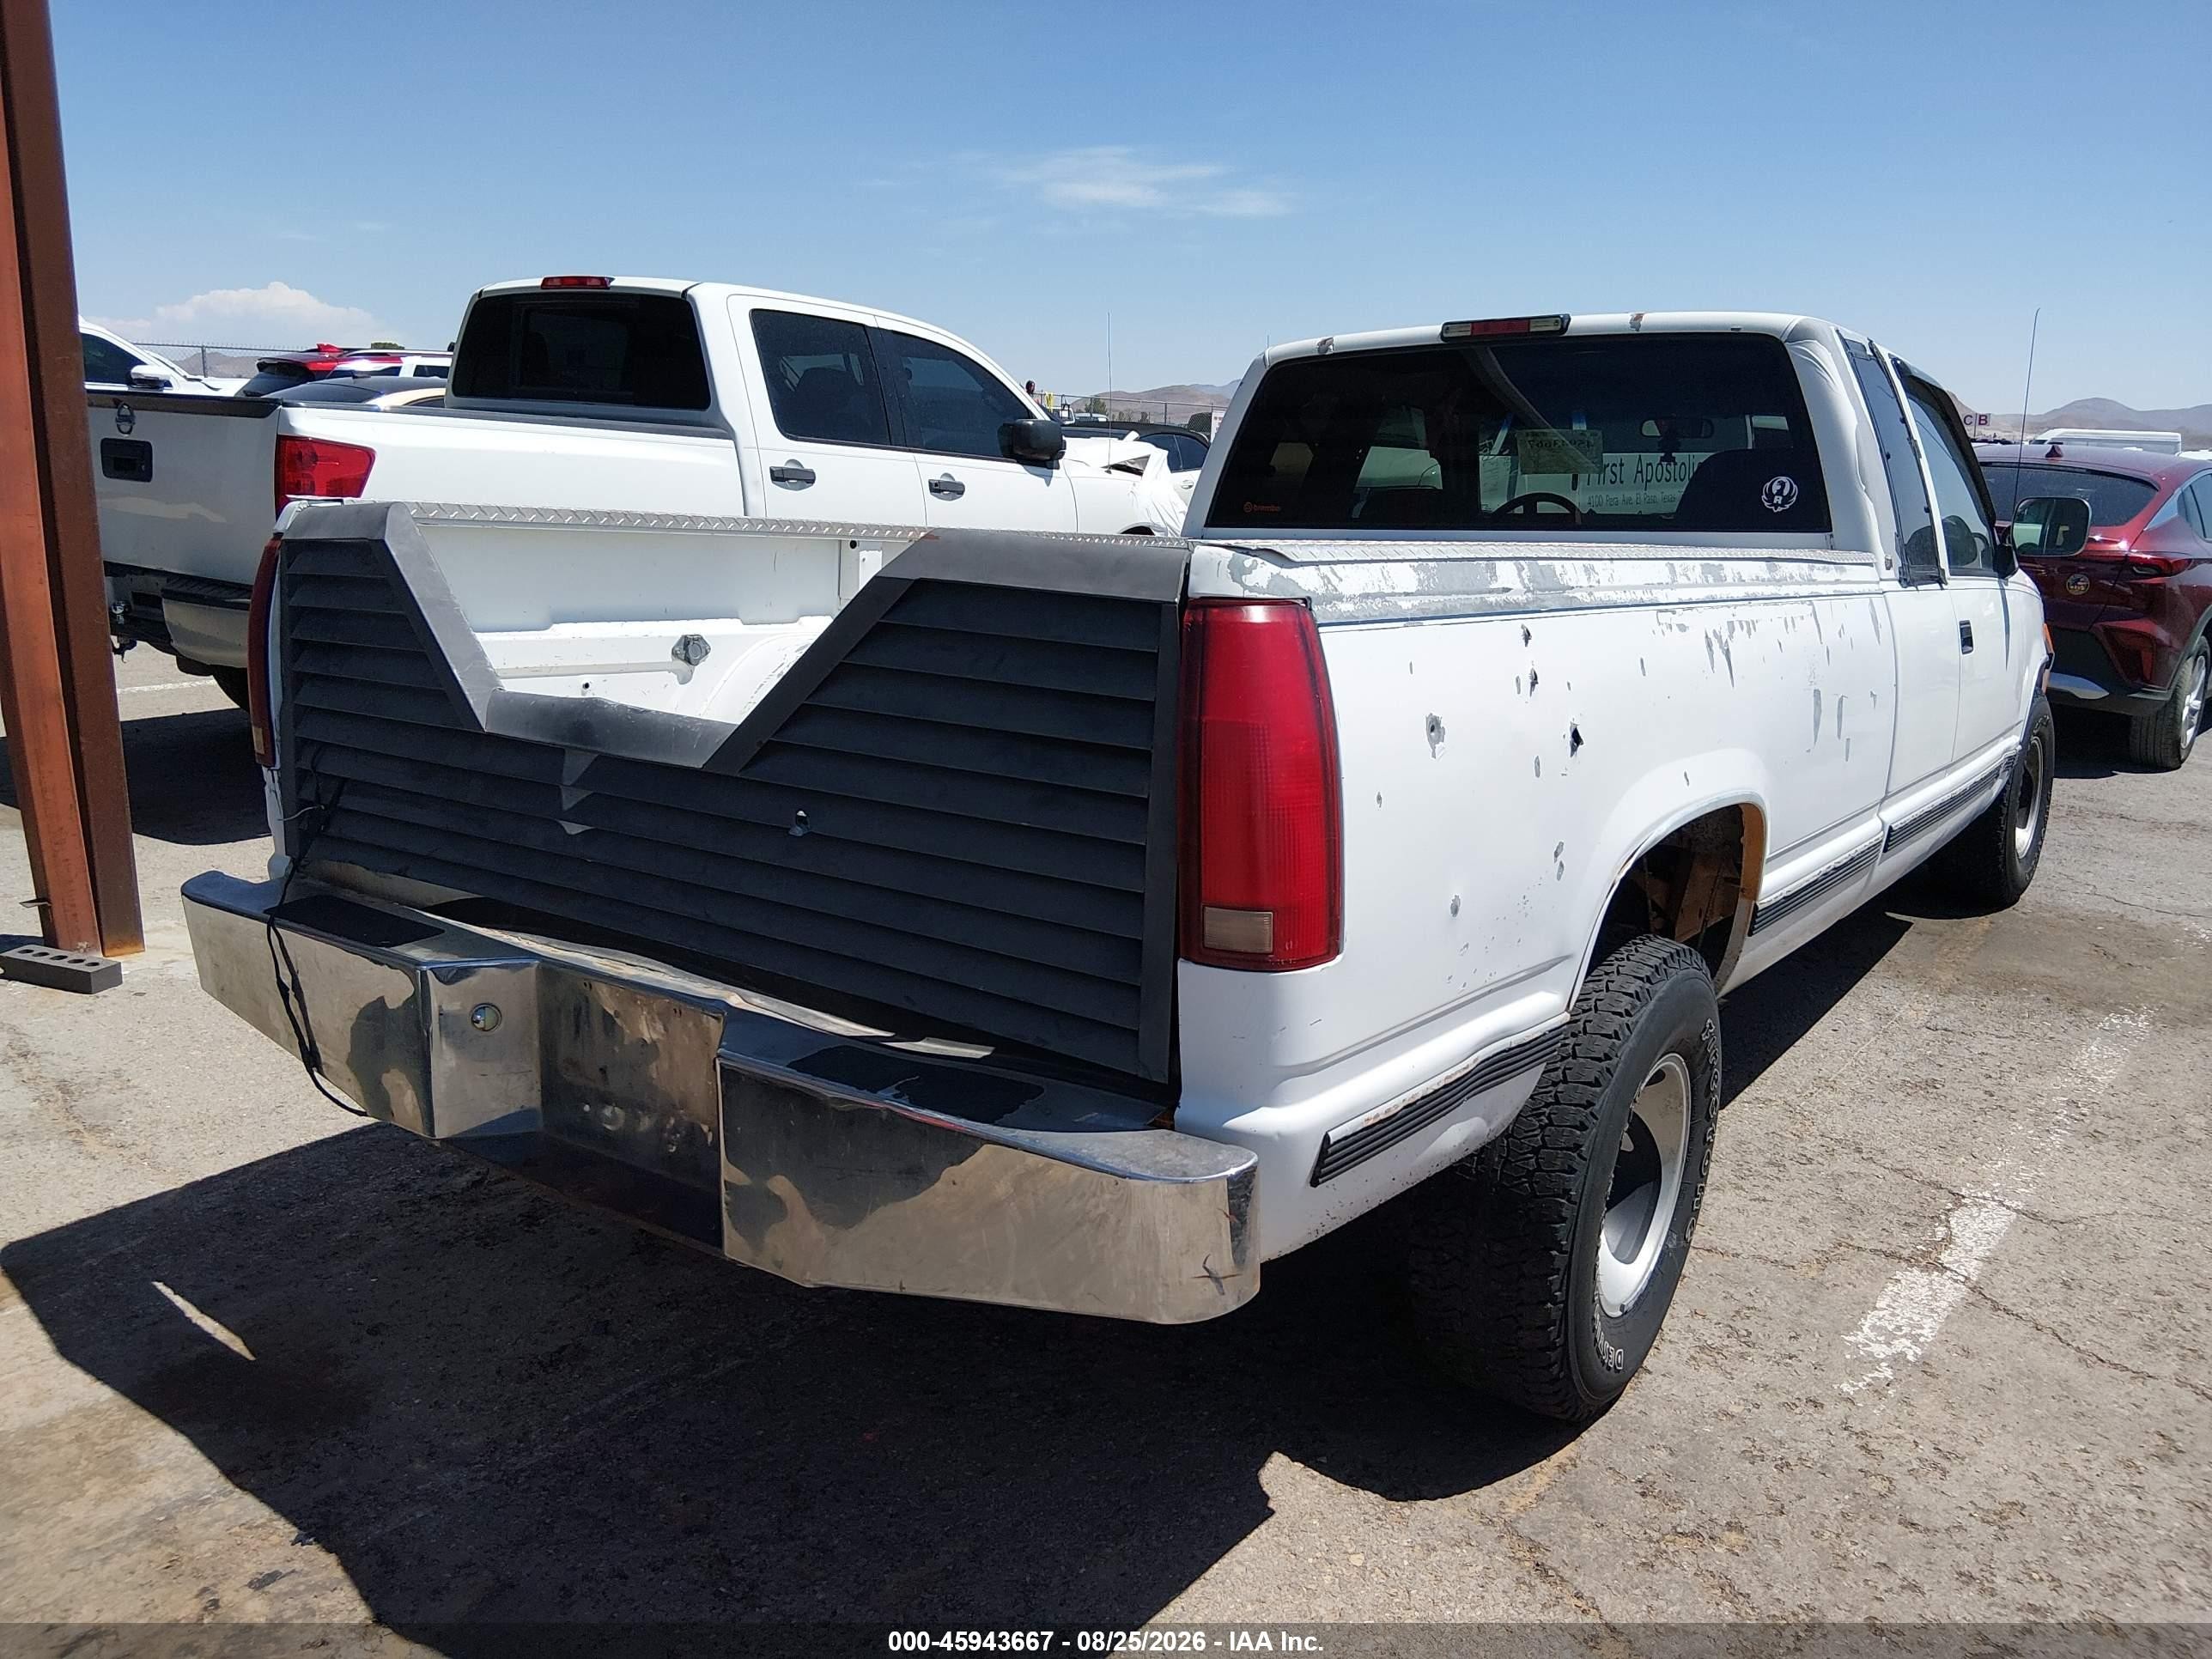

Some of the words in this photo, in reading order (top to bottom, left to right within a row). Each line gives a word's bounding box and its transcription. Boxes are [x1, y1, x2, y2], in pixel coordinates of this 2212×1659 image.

[1963, 414, 1973, 426] C
[1978, 414, 1989, 426] B
[1633, 453, 1702, 491] Apostoli
